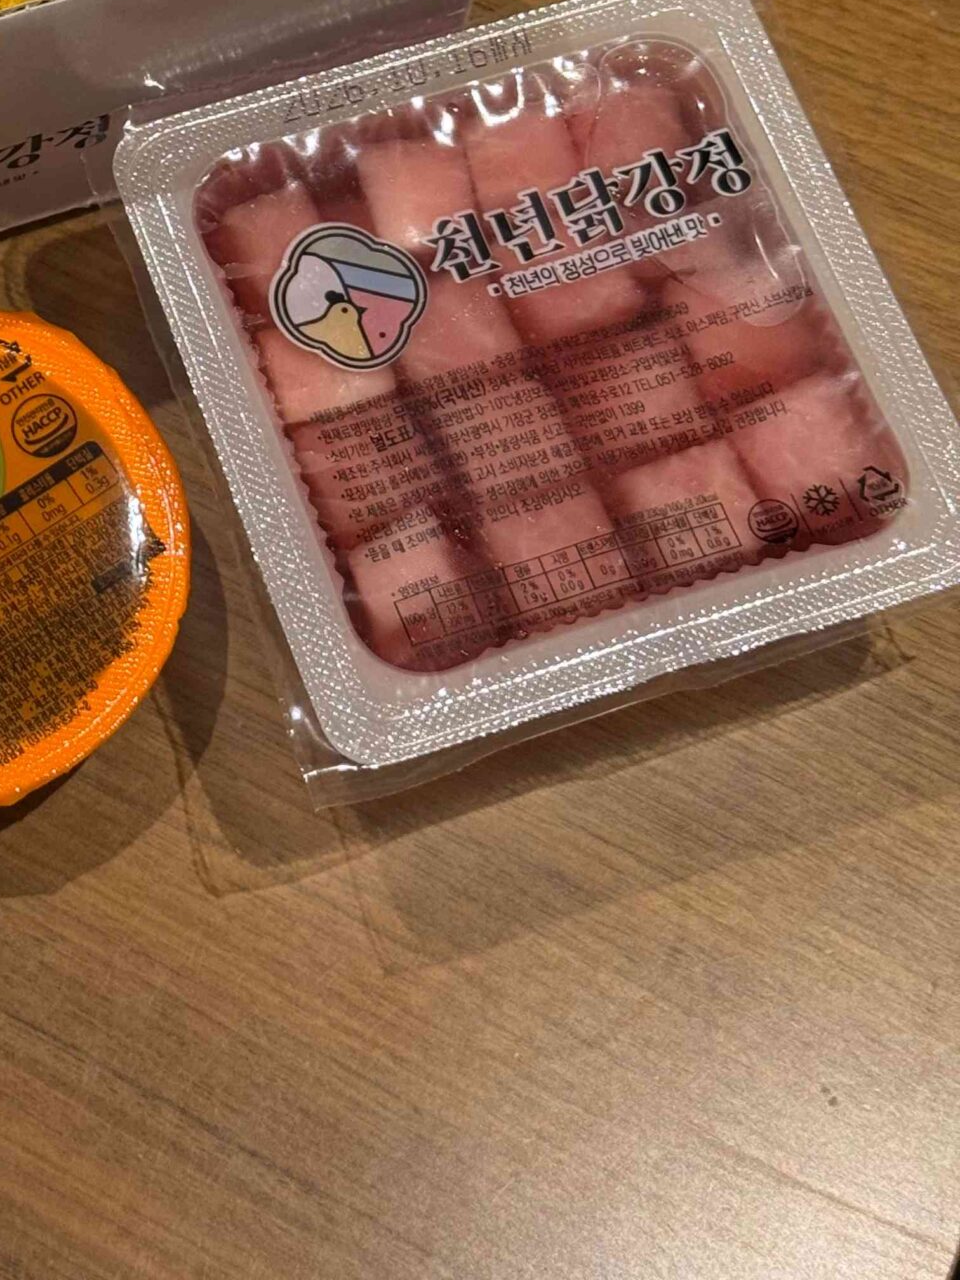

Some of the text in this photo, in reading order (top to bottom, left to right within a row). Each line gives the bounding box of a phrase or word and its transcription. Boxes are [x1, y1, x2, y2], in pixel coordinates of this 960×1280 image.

[422, 128, 754, 287] 천년닭강정
[506, 217, 707, 296] 천년의 정성으로 빚어낸 맛
[21, 406, 63, 439] HACCP
